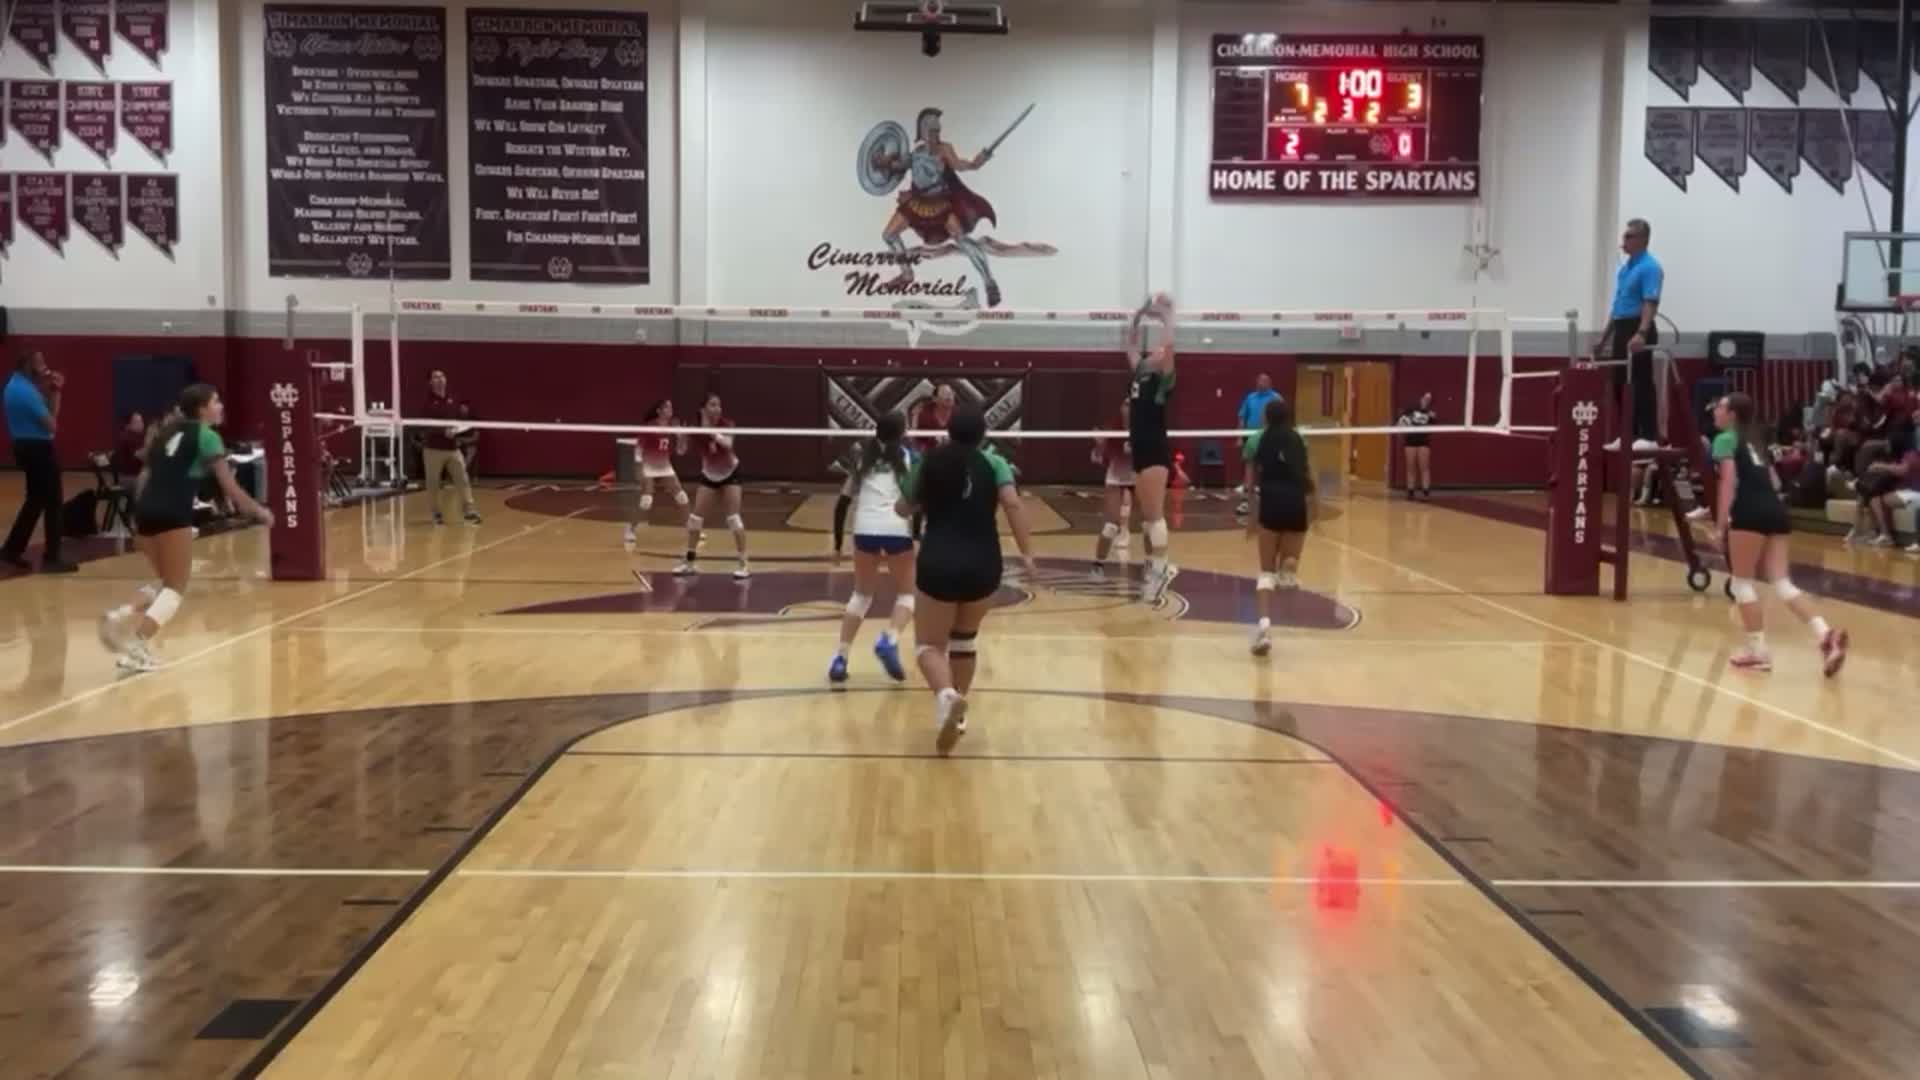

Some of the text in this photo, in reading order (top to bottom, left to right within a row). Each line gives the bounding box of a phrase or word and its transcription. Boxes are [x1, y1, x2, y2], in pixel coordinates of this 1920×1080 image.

[1217, 43, 1480, 58] CIMARRON-MEMORIAL HIGH SCHOOL
[1275, 72, 1309, 82] HOME
[1339, 69, 1382, 97] 1:00
[1295, 83, 1309, 106] 7
[1407, 83, 1422, 109] 3
[1313, 99, 1328, 123] 2
[1342, 99, 1354, 119] 3
[1366, 101, 1380, 123] 2
[1285, 134, 1299, 155] 2
[1398, 134, 1411, 156] 0
[1213, 171, 1475, 191] HOME OF THE SPARTANS
[808, 242, 922, 270] Cimarron
[844, 272, 966, 296] Memorial
[280, 411, 298, 528] SPARTANS
[1574, 428, 1589, 544] SPARTANS
